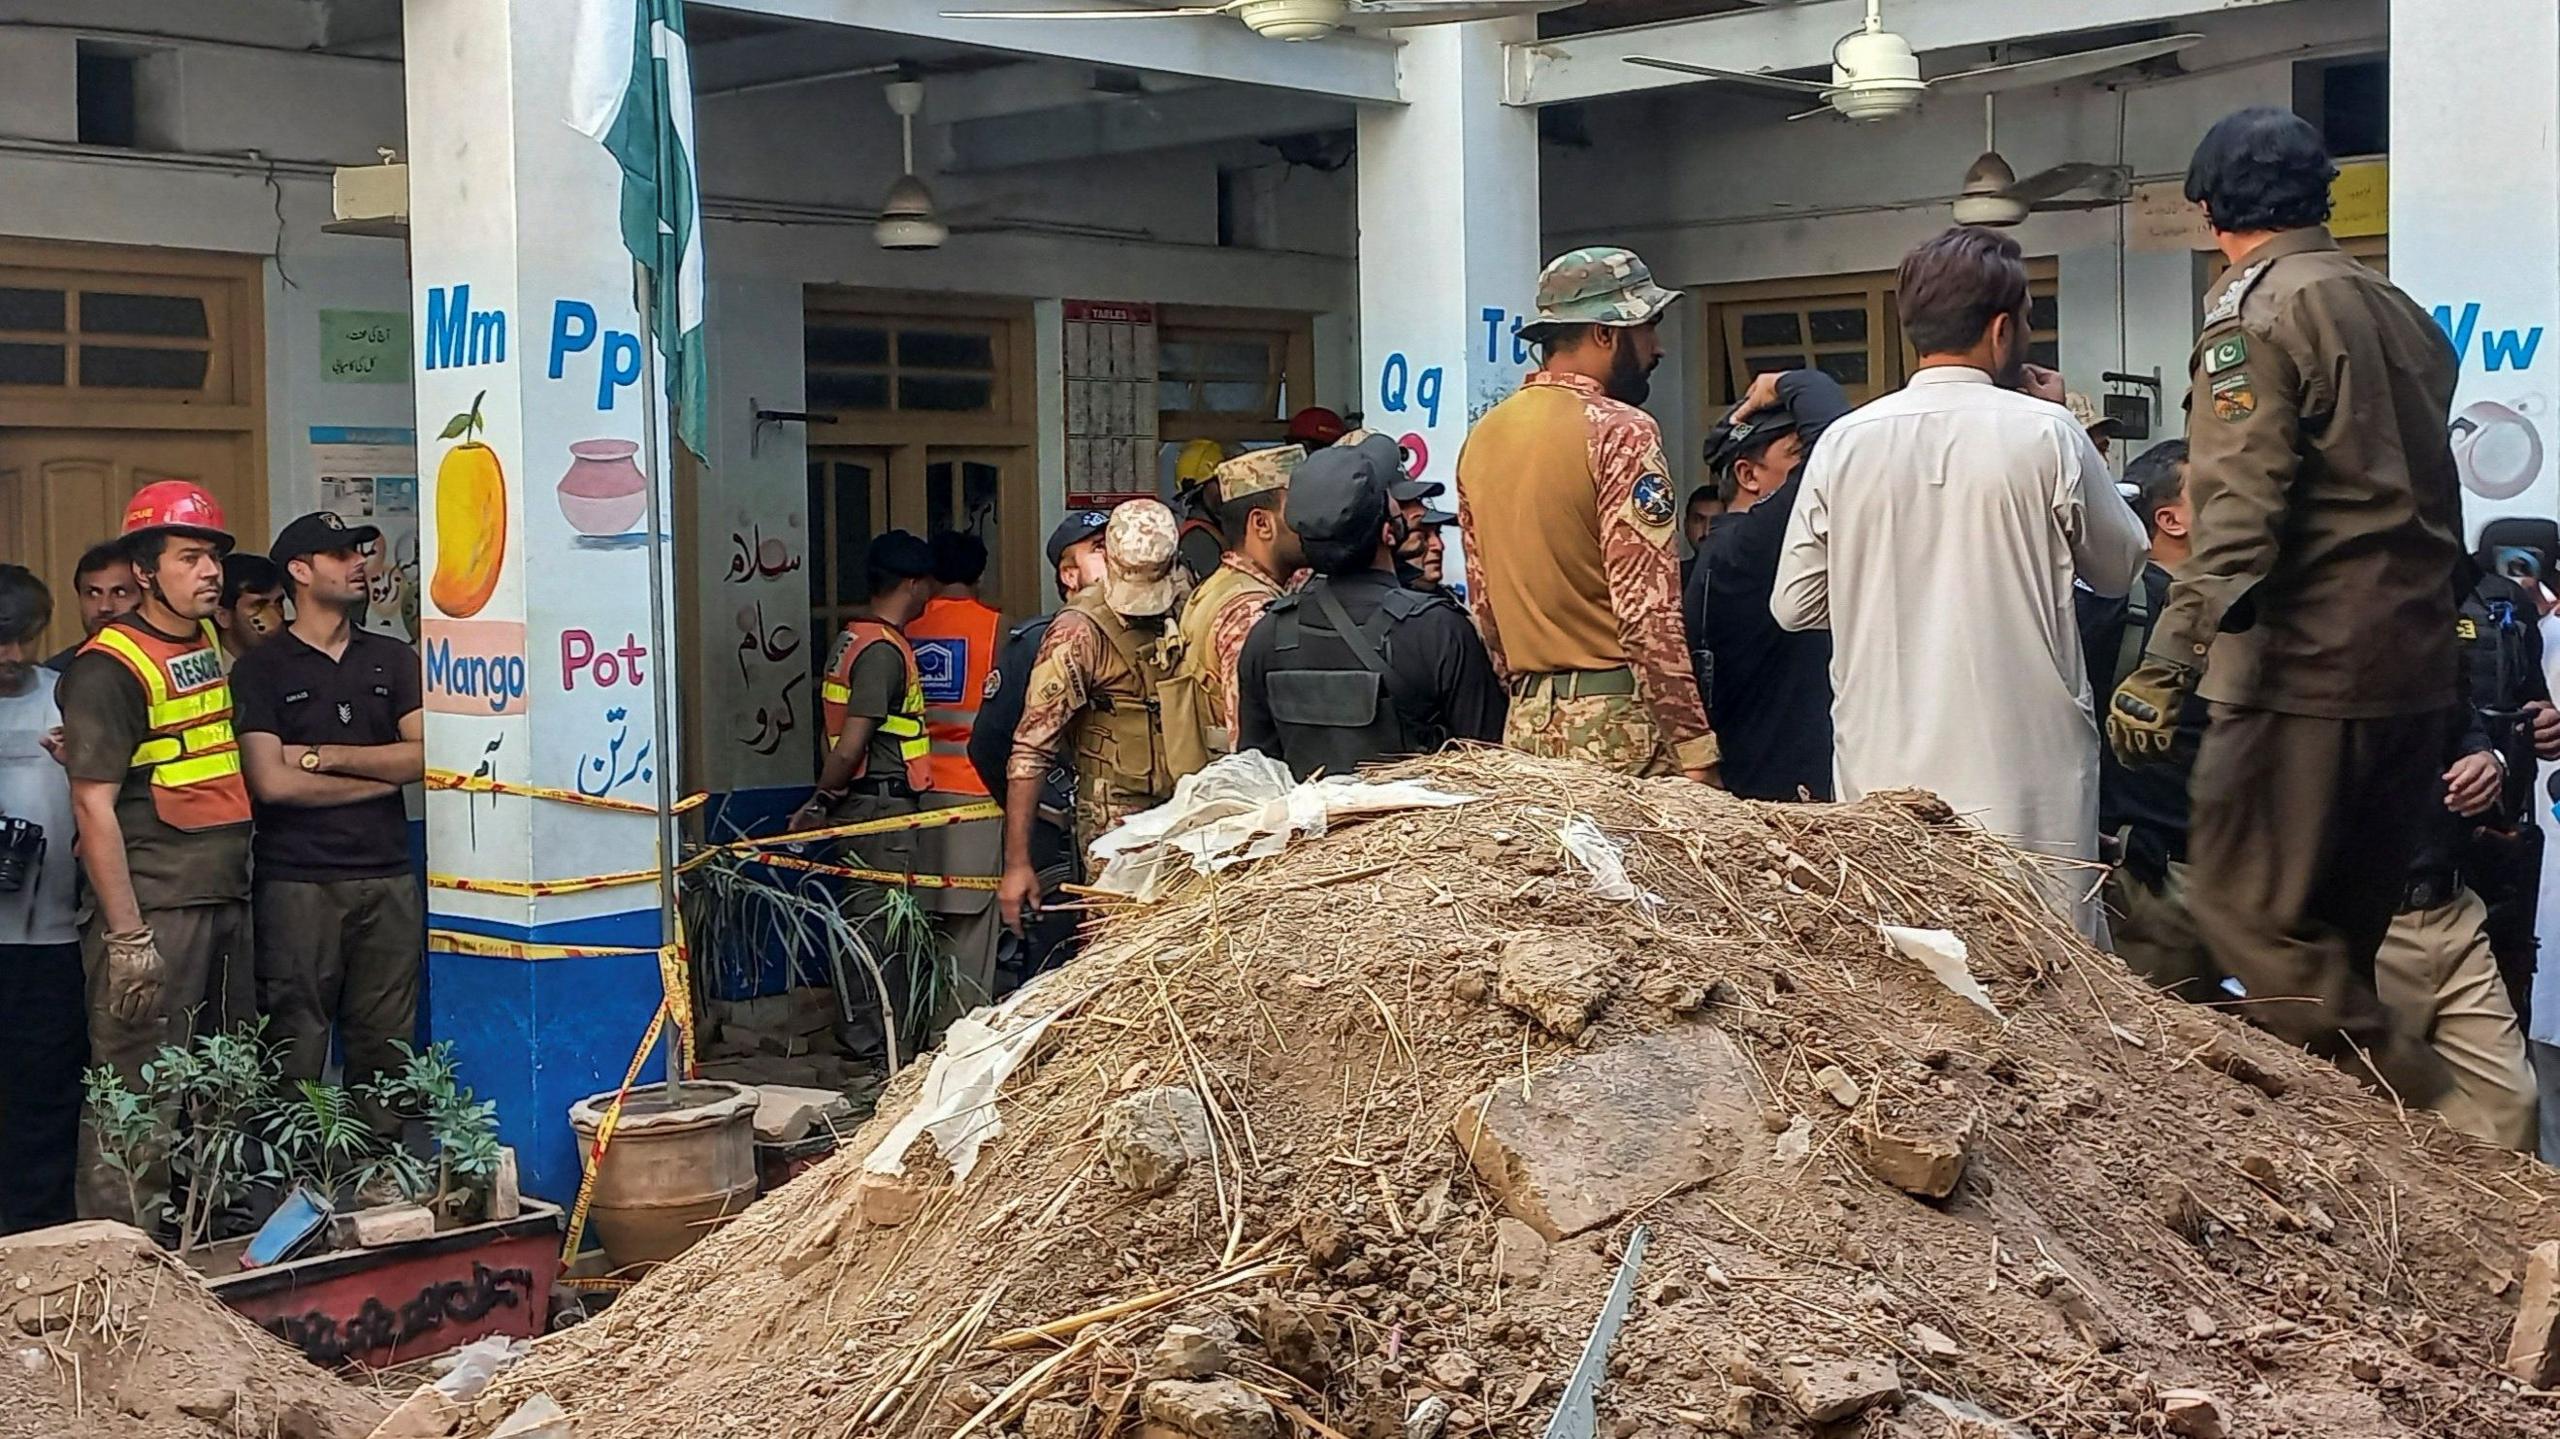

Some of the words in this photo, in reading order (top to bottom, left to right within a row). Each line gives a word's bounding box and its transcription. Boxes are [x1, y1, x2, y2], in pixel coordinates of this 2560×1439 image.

[426, 284, 506, 370] Mm
[1091, 309, 1128, 320] TABLES
[1482, 308, 1528, 365] Tt
[548, 300, 642, 410] Pp
[1381, 353, 1443, 428] Qq
[723, 523, 801, 583] سلام
[427, 637, 525, 712] Mango
[561, 629, 647, 691] Pot
[738, 600, 800, 690] عام
[577, 706, 653, 798] برتن
